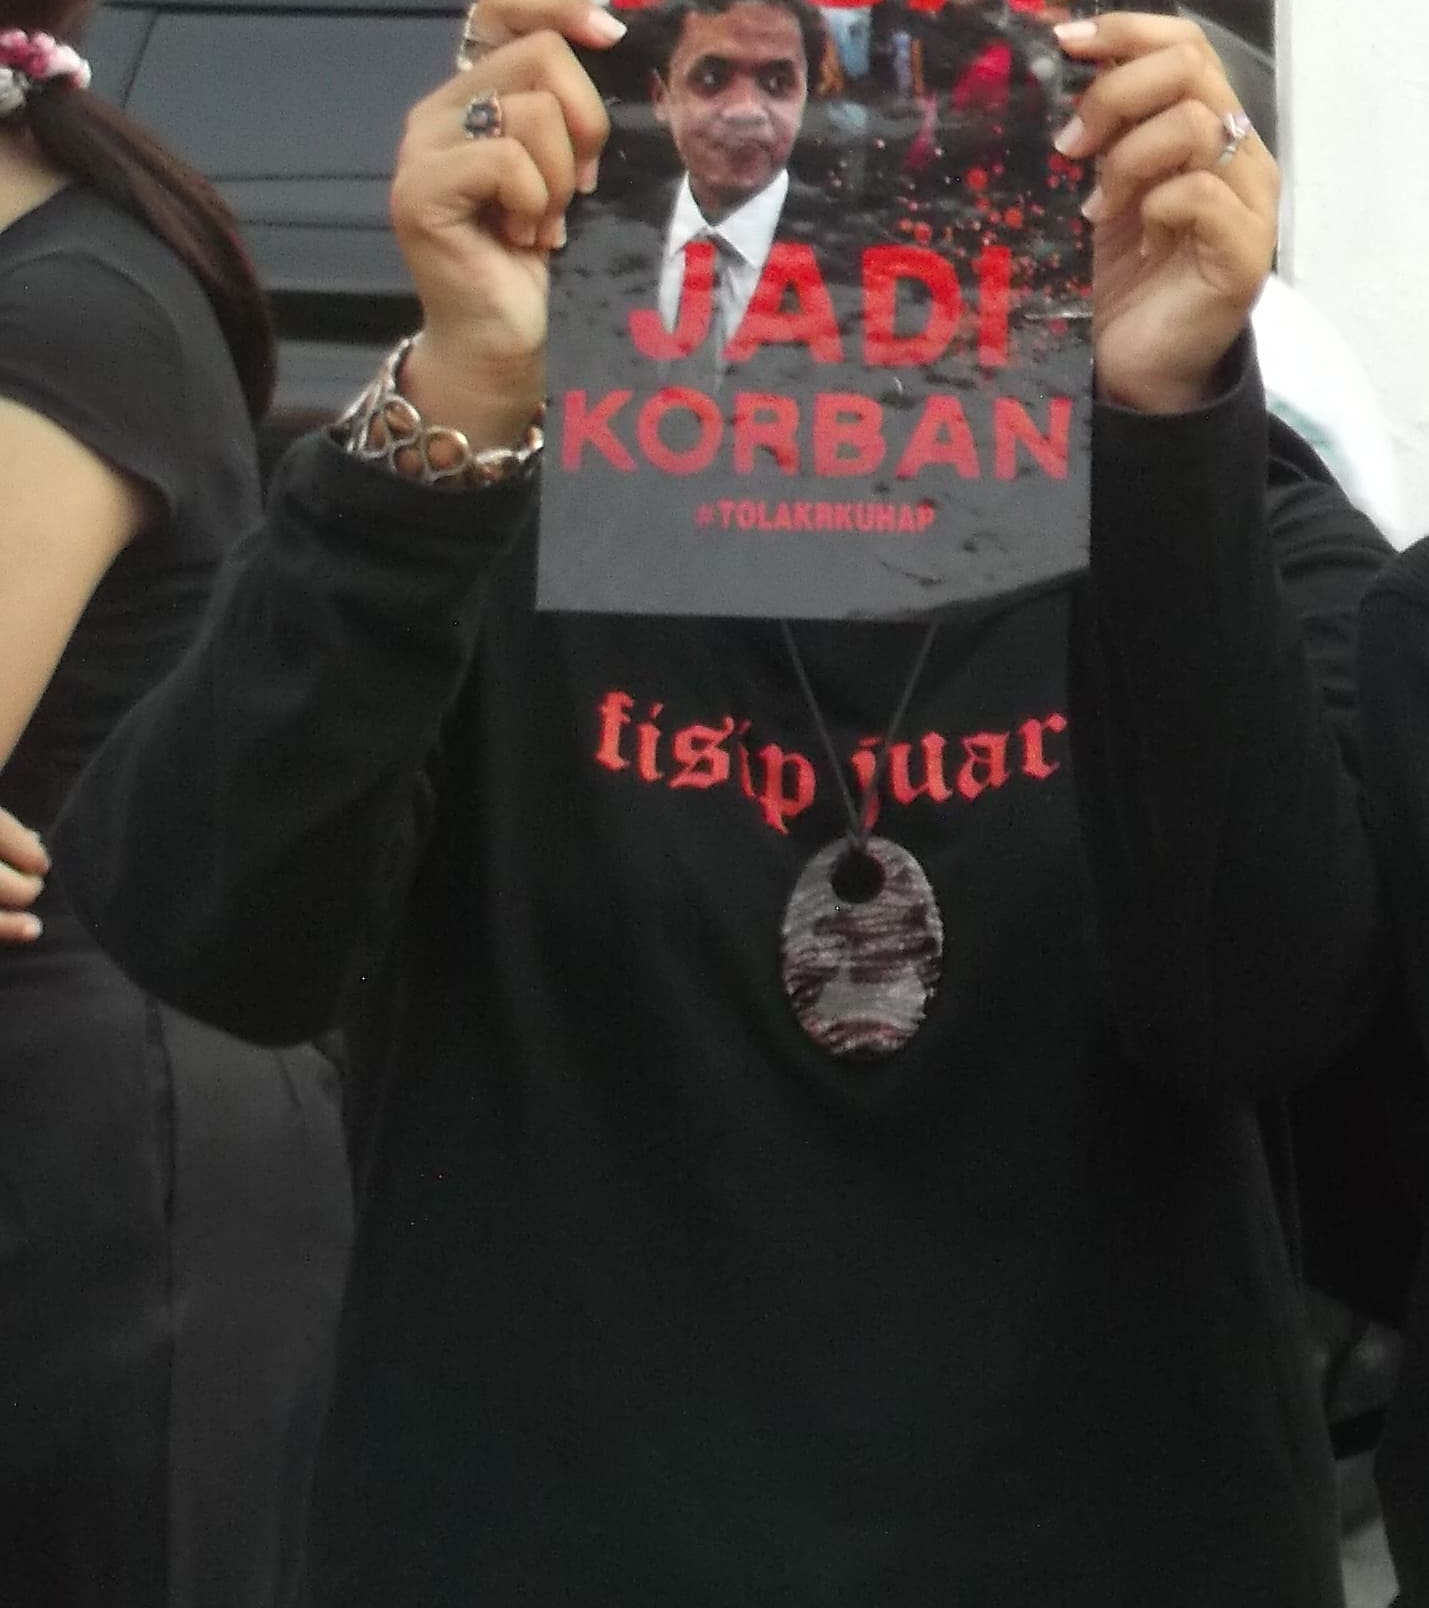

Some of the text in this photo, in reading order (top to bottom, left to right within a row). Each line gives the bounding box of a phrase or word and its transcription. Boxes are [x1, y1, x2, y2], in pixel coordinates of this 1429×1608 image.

[628, 241, 1012, 368] JADI
[563, 386, 1074, 478] KORBAN
[696, 499, 936, 533] #TOLAKRKUHAP
